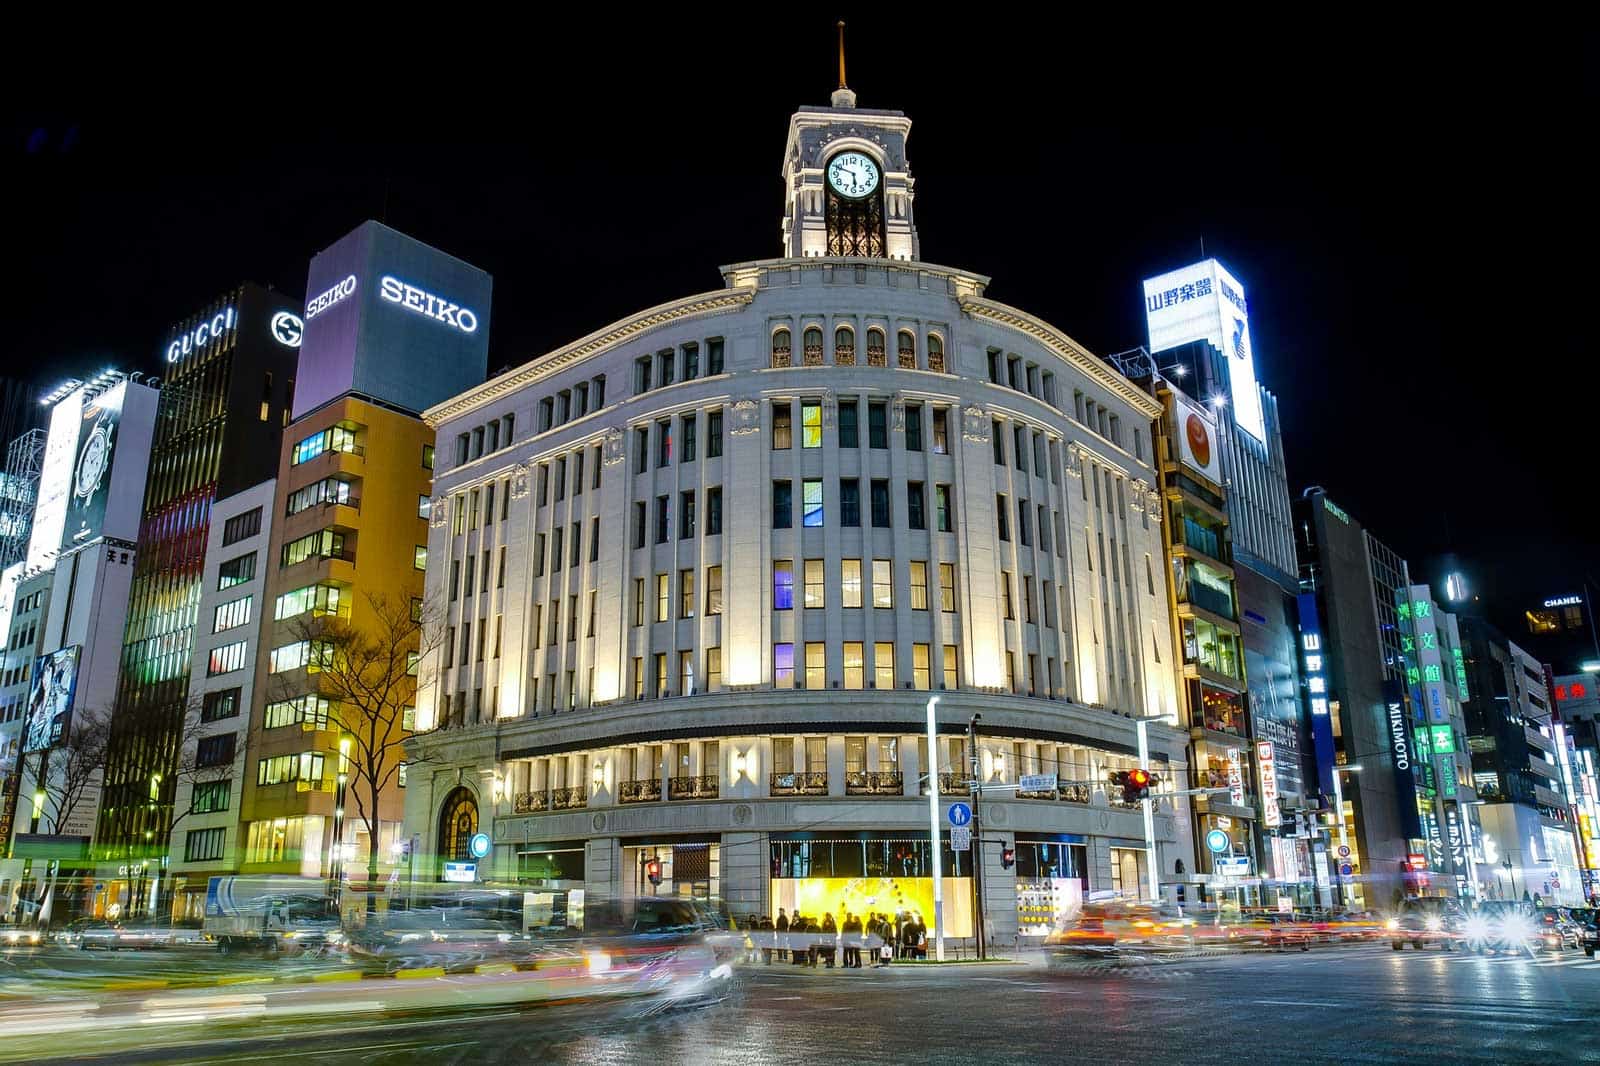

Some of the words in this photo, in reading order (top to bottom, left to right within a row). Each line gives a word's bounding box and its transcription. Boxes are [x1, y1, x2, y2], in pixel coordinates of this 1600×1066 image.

[306, 274, 357, 320] SEIKO
[381, 276, 477, 332] SEIKO
[1147, 278, 1212, 312] 山野楽器
[167, 307, 233, 362] GUCCI
[1544, 596, 1582, 607] CHANEL
[1415, 600, 1440, 682] 教文館
[1389, 703, 1408, 770] MIKIMOTO
[1435, 731, 1450, 750] 本
